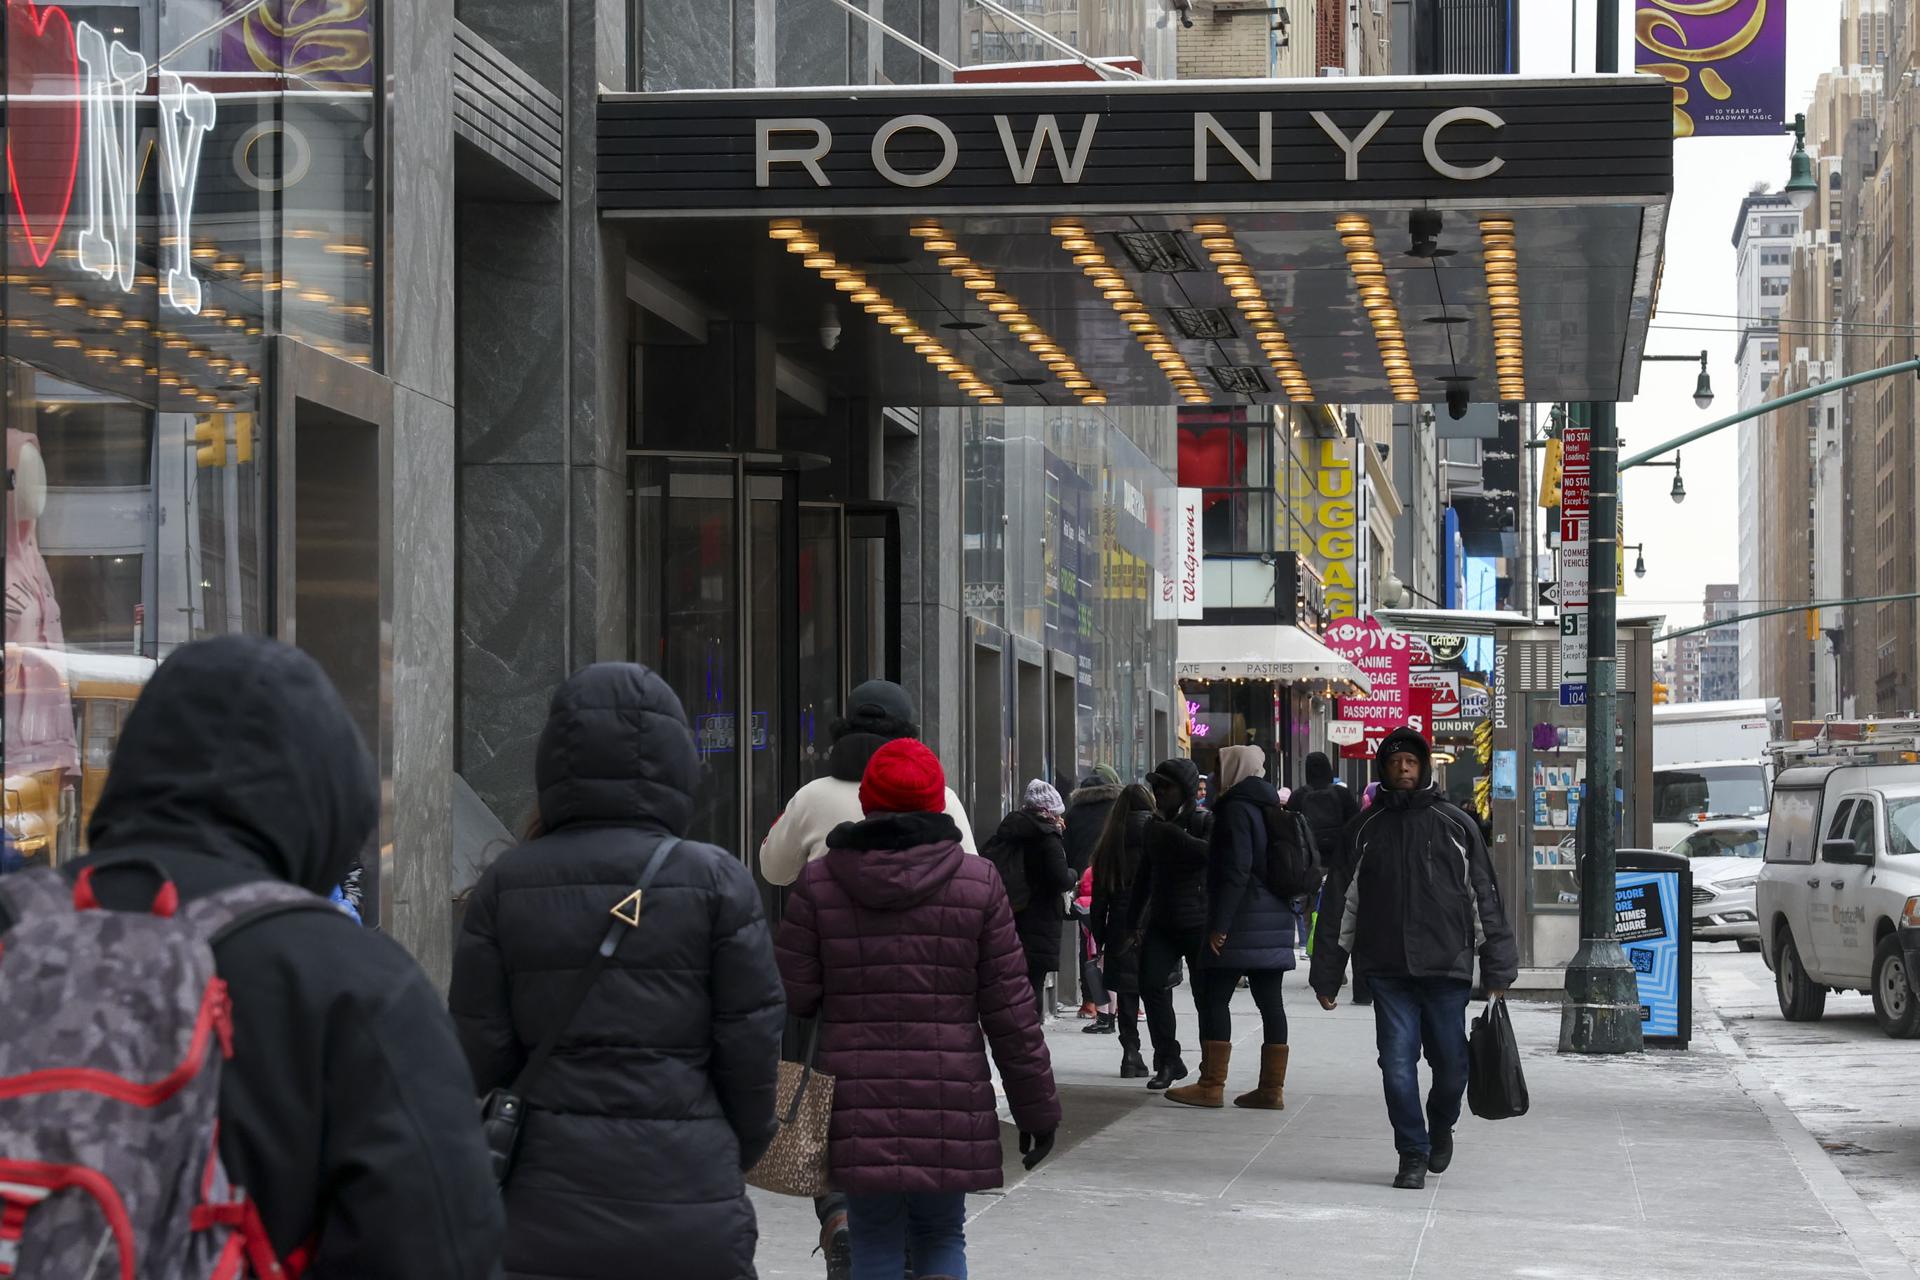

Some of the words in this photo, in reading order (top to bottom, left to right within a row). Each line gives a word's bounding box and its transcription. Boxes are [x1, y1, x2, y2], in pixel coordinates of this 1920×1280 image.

[755, 113, 1100, 189] ROW
[1194, 106, 1507, 182] NYC
[1566, 433, 1575, 441] NO
[1565, 444, 1579, 452] Hotel
[1564, 478, 1574, 486] NO
[1317, 440, 1356, 620] LUGGAG
[1567, 521, 1573, 540] 1
[1183, 504, 1200, 603] Walgreens
[1563, 559, 1589, 567] VEHICLE
[1564, 615, 1573, 634] 5
[1328, 624, 1368, 642] TOY
[1246, 663, 1294, 673] PASTRIES
[1357, 656, 1392, 669] ANIME
[1494, 644, 1508, 729] Newsstand
[1569, 692, 1587, 704] 104
[1343, 705, 1387, 719] PASSPORT
[1389, 706, 1403, 719] PIC
[1335, 726, 1357, 734] ATM
[1432, 721, 1475, 731] OUNDRY
[1615, 887, 1644, 900] PLORE
[1615, 900, 1633, 911] ORE
[1620, 908, 1647, 921] TIMES
[1615, 919, 1647, 933] QUARE
